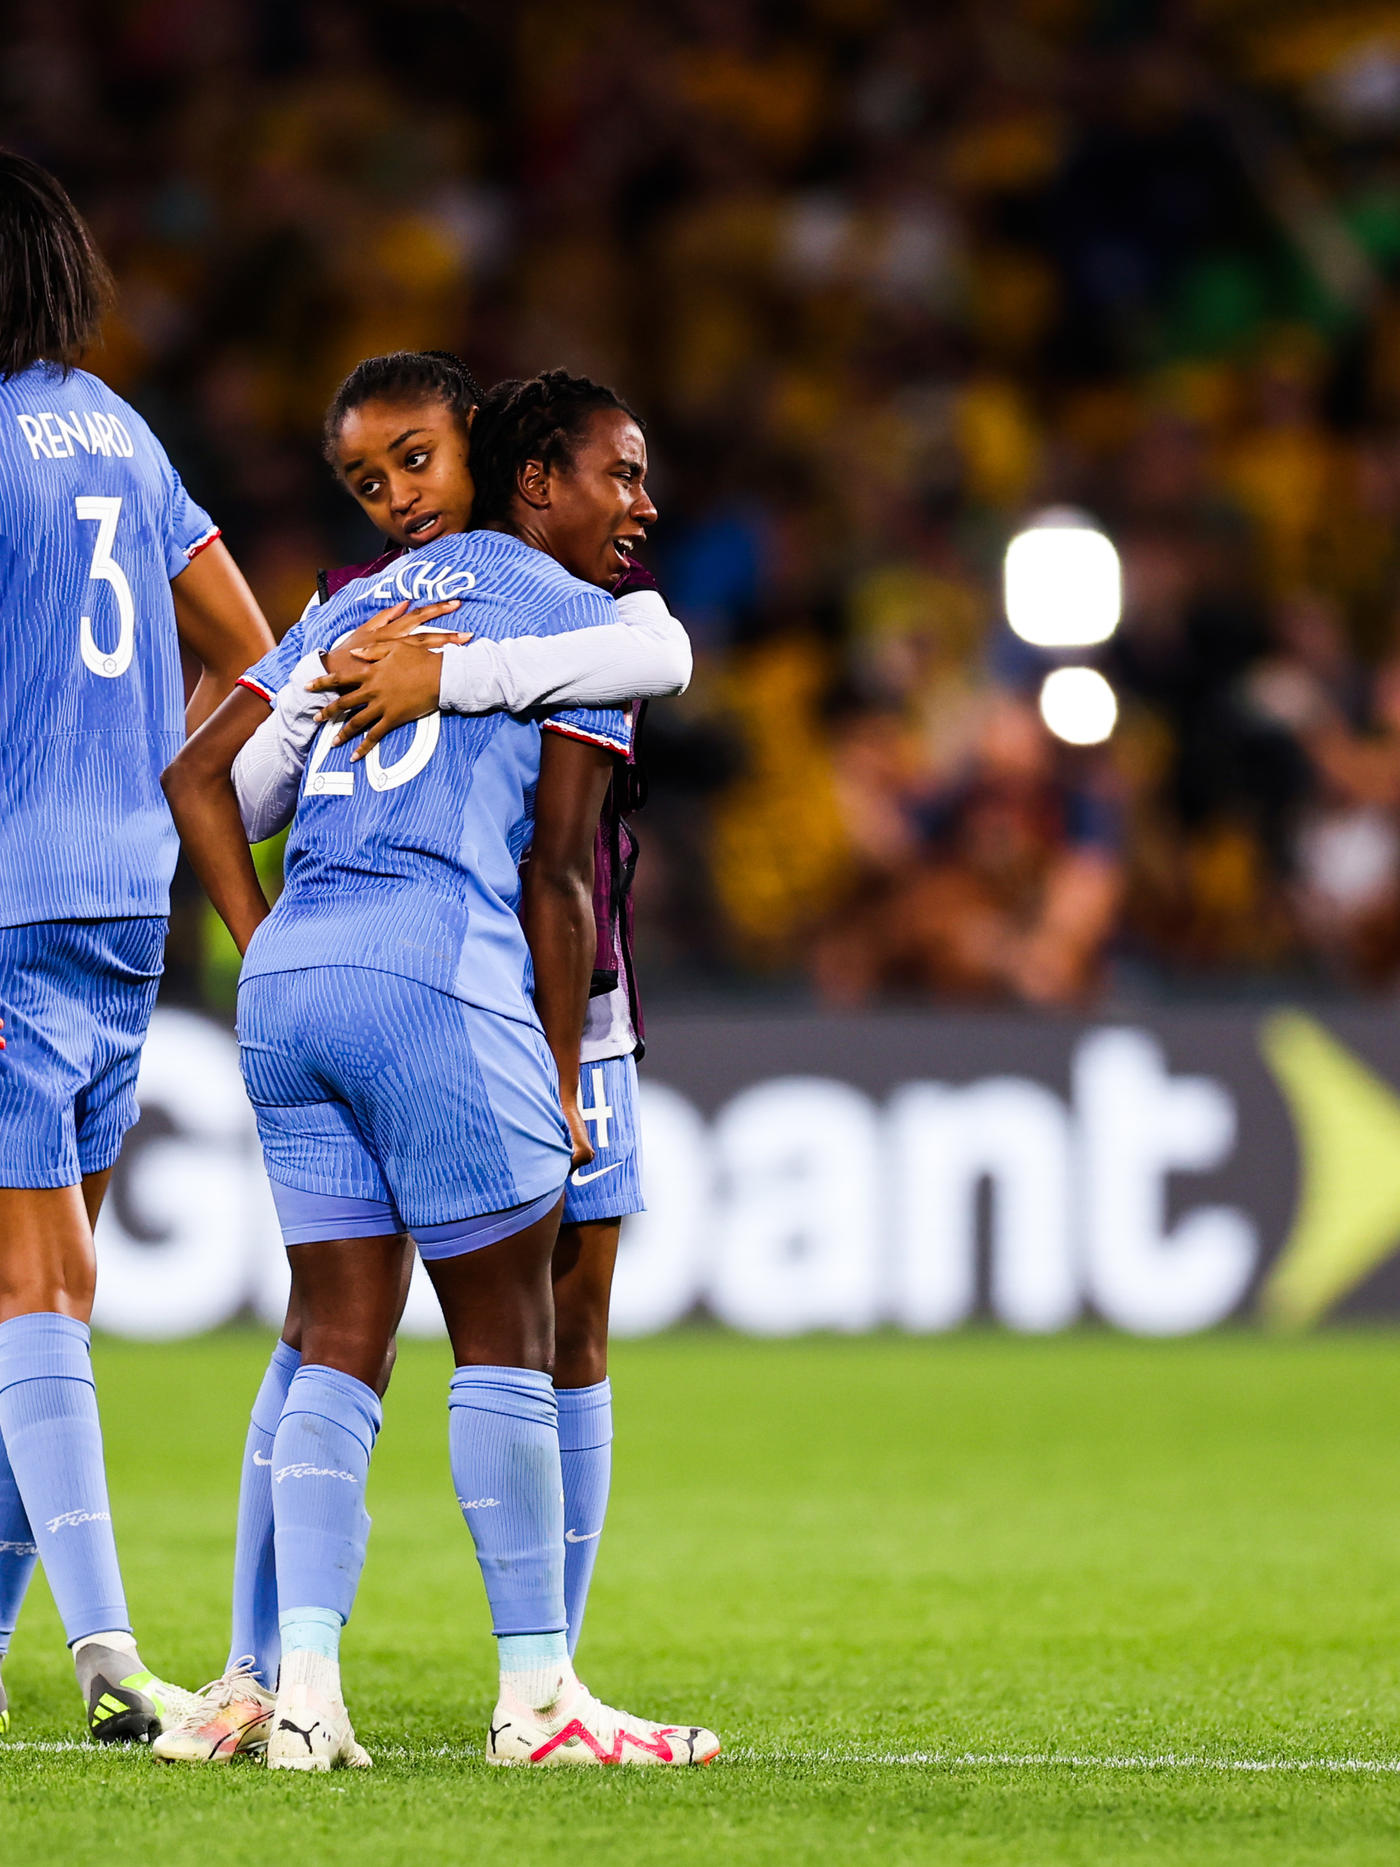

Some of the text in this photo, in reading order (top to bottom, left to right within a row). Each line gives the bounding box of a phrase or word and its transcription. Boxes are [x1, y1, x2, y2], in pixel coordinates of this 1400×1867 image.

[17, 410, 134, 460] RENARD
[75, 496, 134, 679] 3
[355, 560, 476, 600] ECHO
[275, 1462, 359, 1484] France
[458, 1496, 501, 1510] ance
